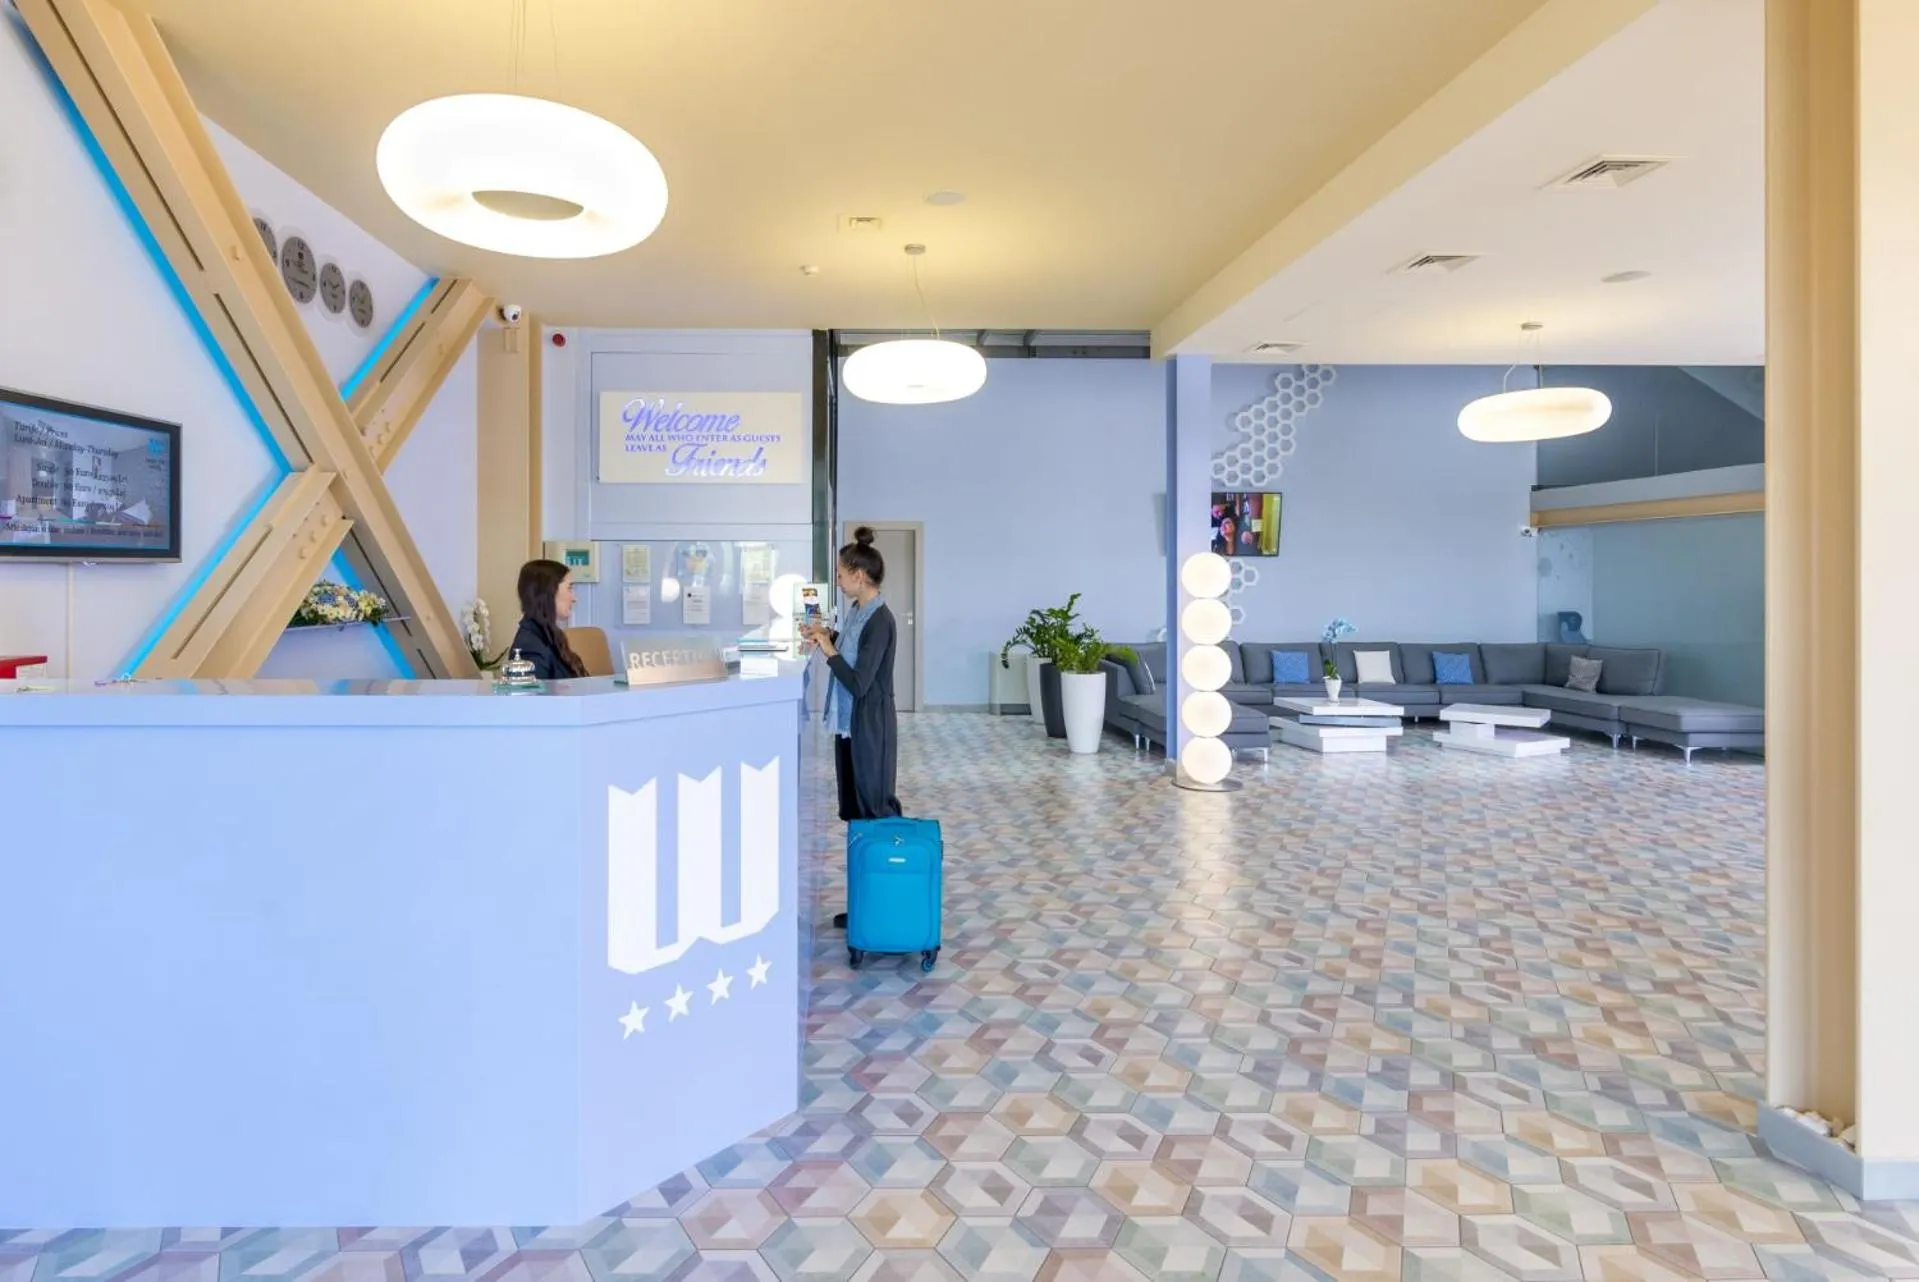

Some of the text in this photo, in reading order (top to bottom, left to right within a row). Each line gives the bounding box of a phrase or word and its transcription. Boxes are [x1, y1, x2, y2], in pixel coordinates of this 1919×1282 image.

[622, 399, 740, 432] Welcome
[625, 434, 781, 442] MAY ALL WHO ENTER AS GUESTS
[625, 444, 667, 452] LEAVE AS
[664, 442, 767, 476] Friends
[629, 648, 720, 669] RECEPTI
